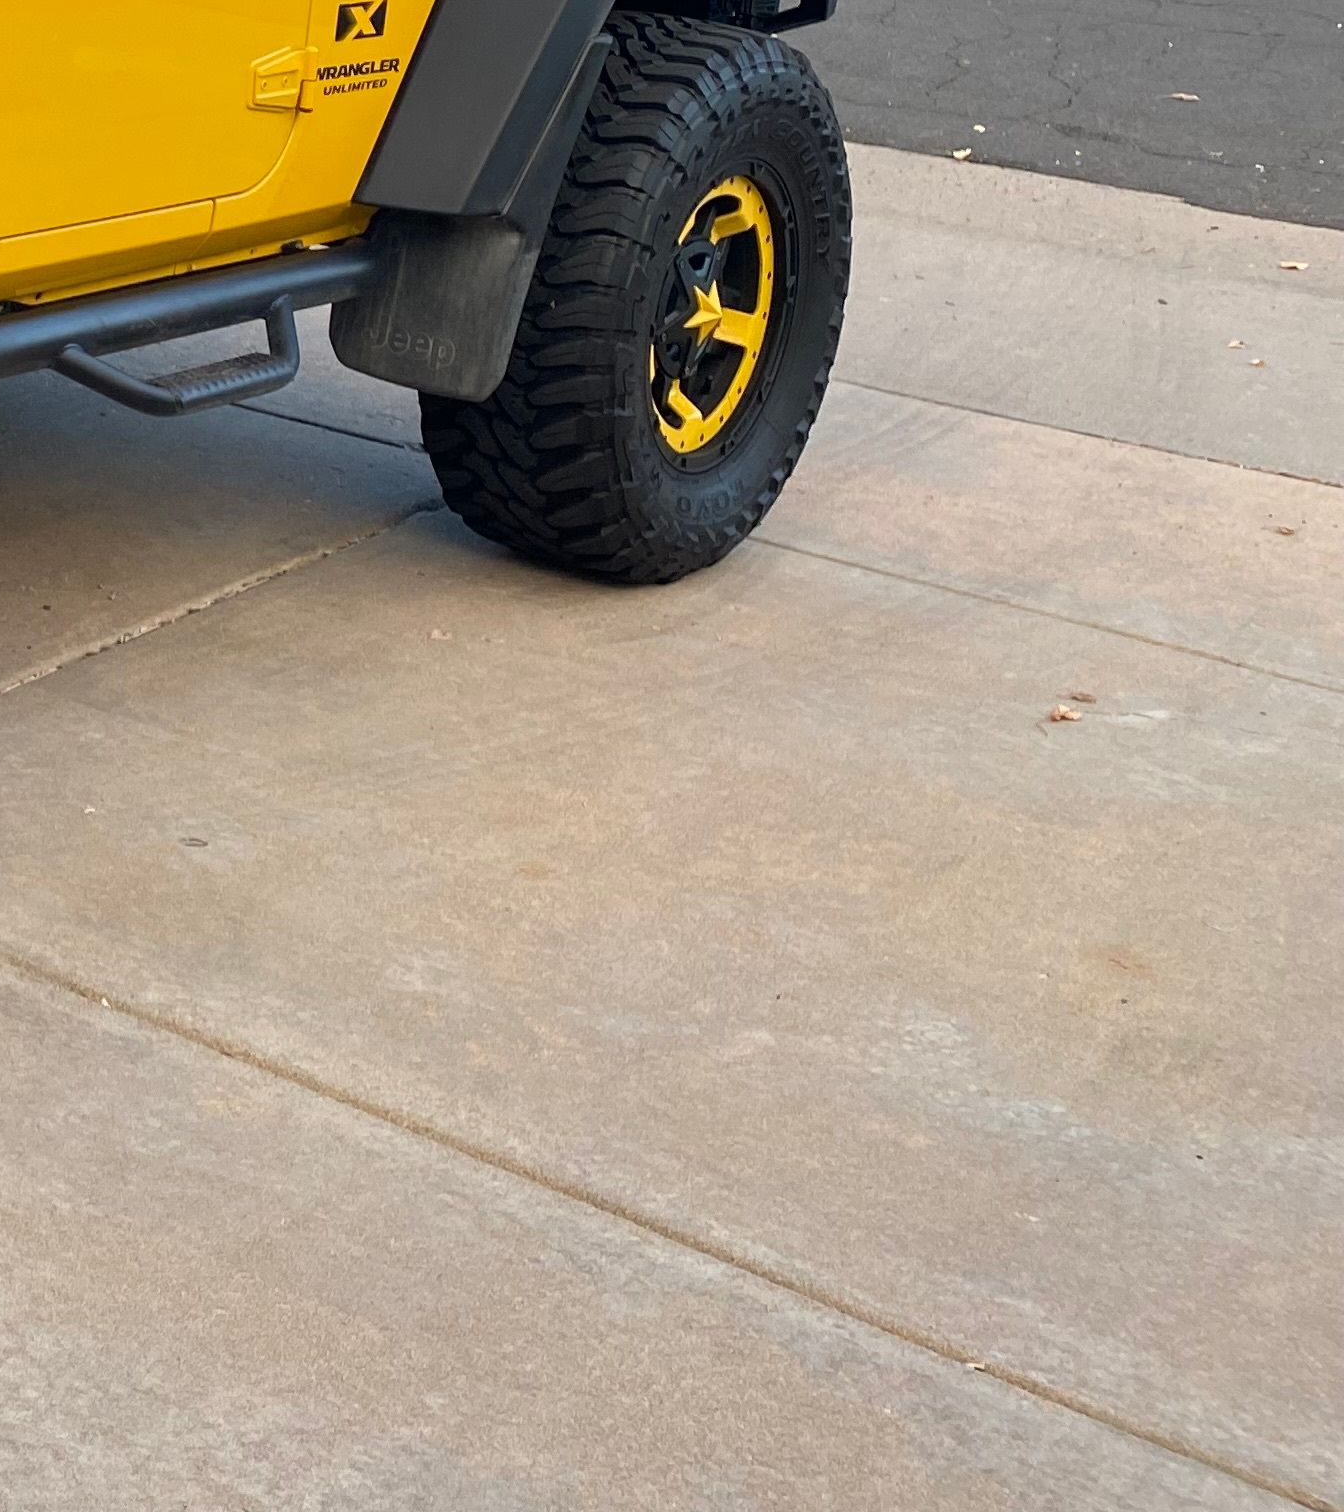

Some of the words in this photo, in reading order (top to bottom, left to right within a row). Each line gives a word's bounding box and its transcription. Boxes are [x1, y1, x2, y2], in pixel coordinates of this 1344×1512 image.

[335, 0, 388, 42] X
[323, 78, 388, 96] UNLIMITED
[776, 119, 831, 268] COUNTRY
[369, 314, 456, 371] Jeep
